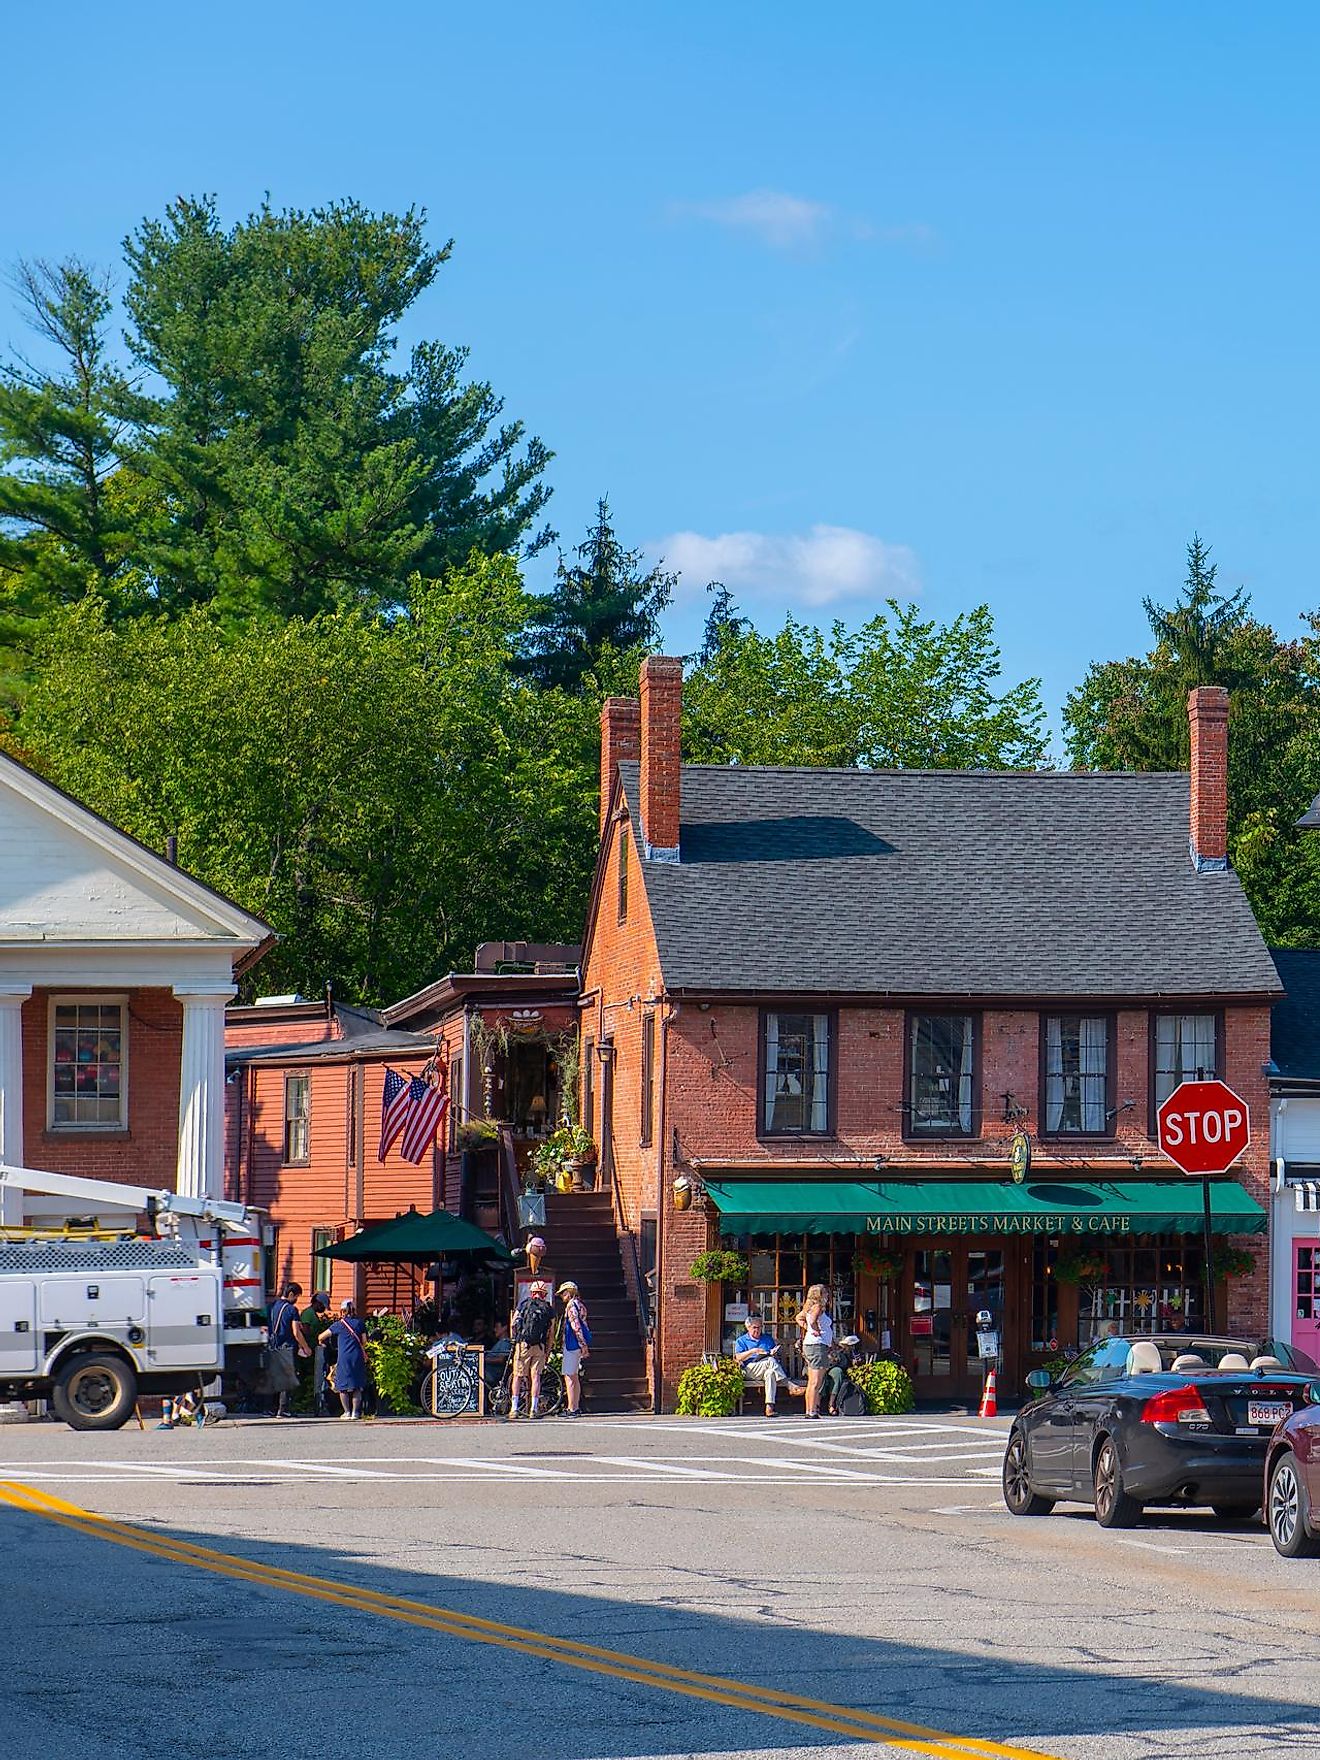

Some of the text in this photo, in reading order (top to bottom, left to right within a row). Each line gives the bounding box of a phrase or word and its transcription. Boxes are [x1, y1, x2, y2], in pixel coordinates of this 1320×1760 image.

[1165, 1109, 1242, 1146] STOP
[866, 1216, 1130, 1231] MAIN STREETS MARKET & CAFE
[1251, 1406, 1270, 1419] 868
